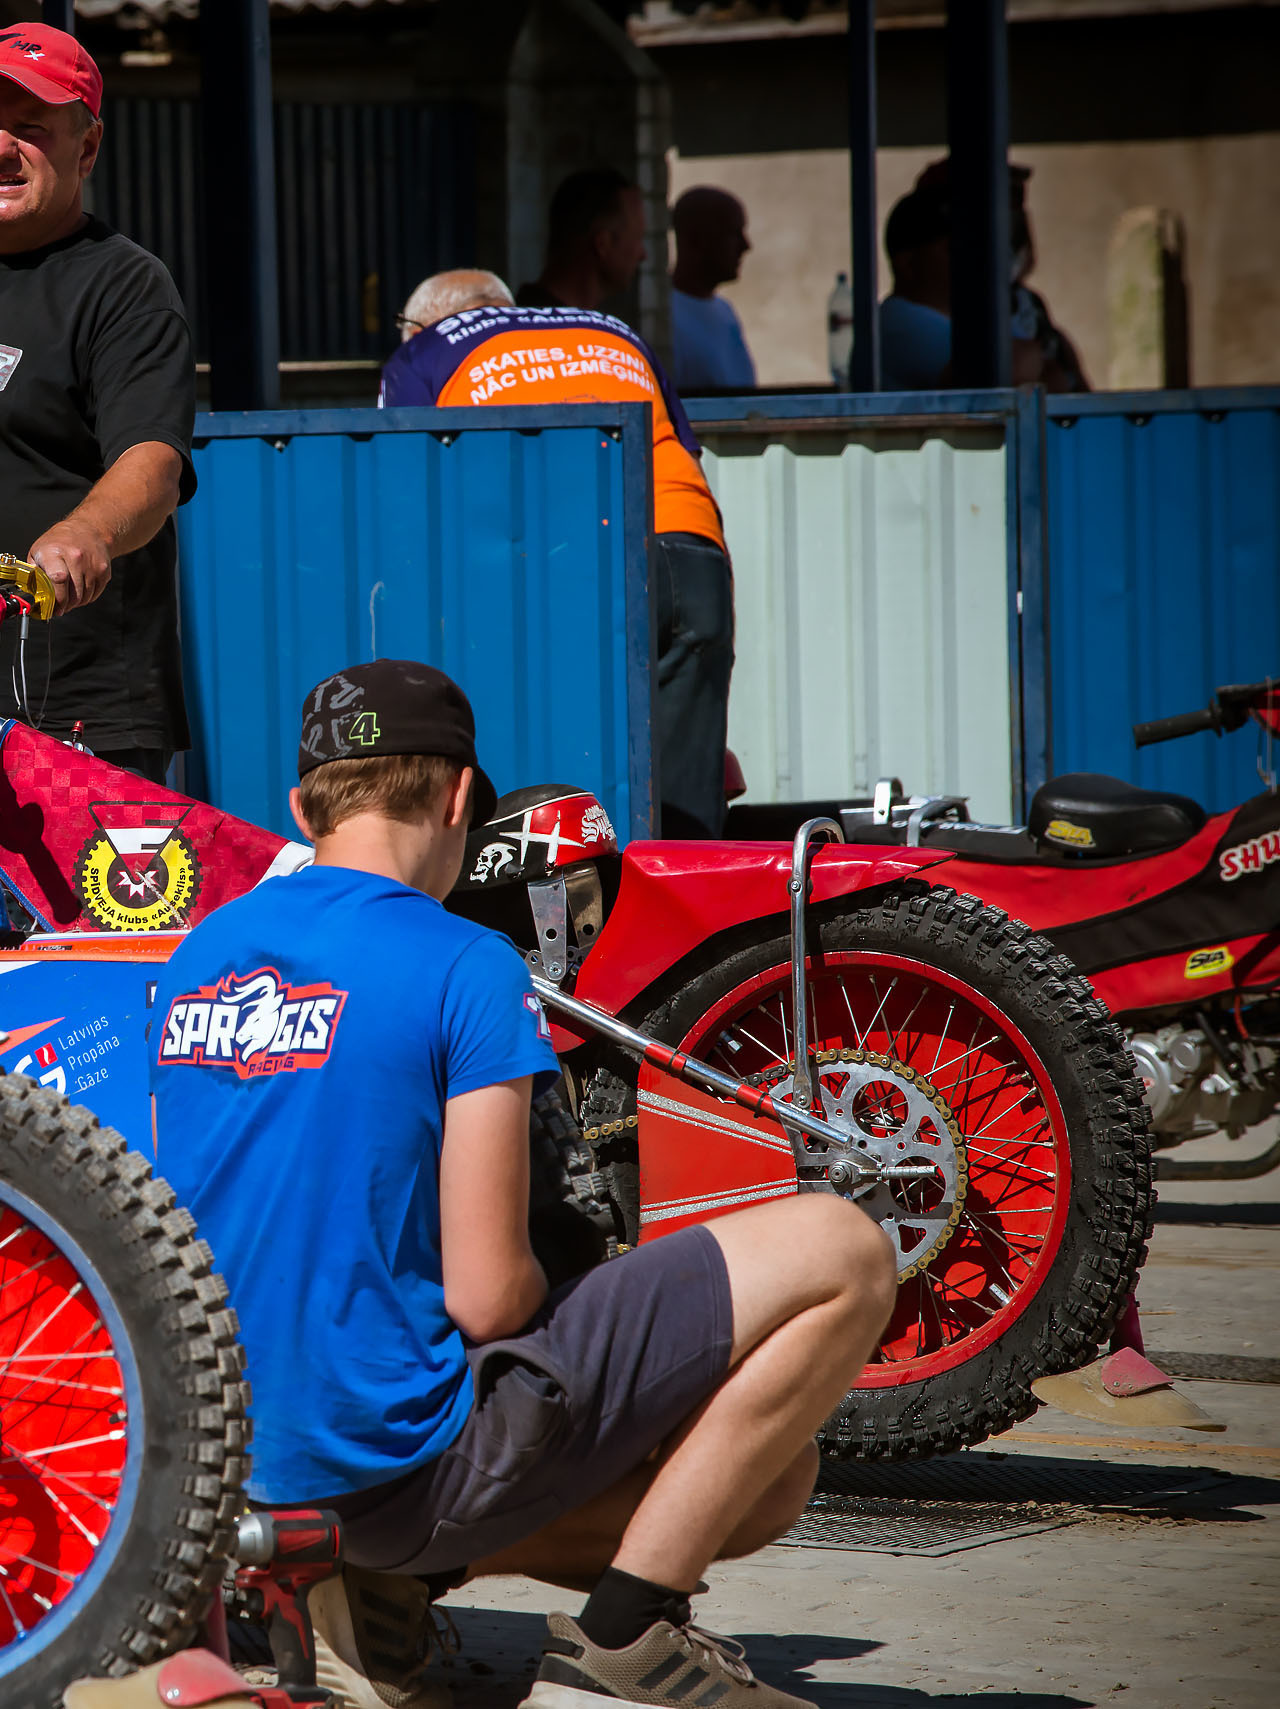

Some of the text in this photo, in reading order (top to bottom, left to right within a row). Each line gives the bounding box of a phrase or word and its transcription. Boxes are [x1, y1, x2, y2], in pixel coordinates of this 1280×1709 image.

[469, 347, 573, 384] SKATIES,
[469, 372, 517, 405] NĀC
[521, 365, 556, 383] UN
[348, 711, 381, 746] 4
[116, 912, 149, 924] klubs
[57, 1015, 109, 1051] Latvijas
[67, 1035, 120, 1071] Propāna
[76, 1067, 109, 1091] Gāze
